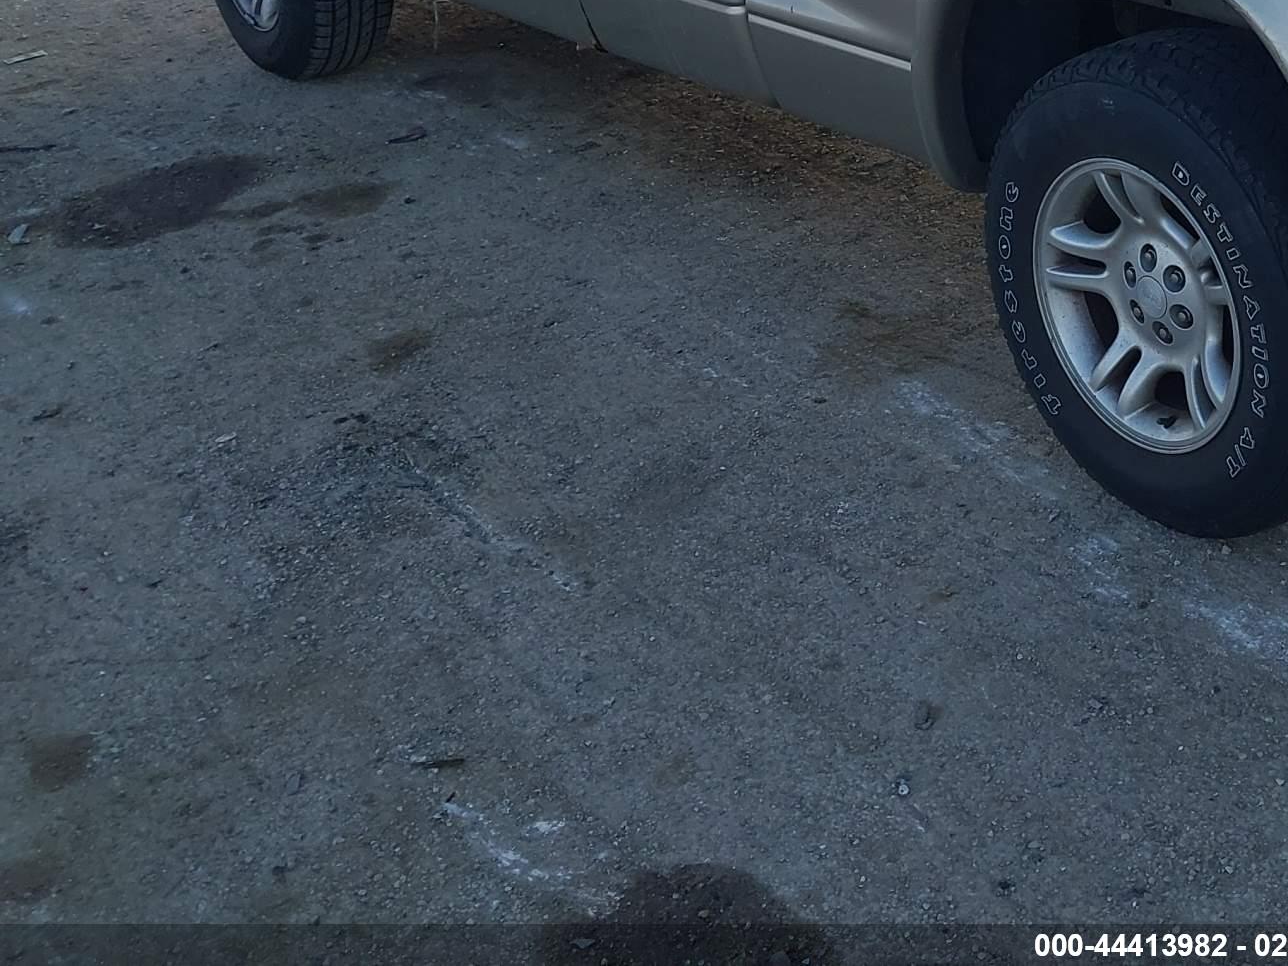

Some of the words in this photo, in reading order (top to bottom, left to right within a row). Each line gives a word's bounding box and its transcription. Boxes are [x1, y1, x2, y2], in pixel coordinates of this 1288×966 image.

[998, 181, 1062, 415] Firestone
[1172, 161, 1270, 418] DESTINATION
[1226, 427, 1255, 478] A/T
